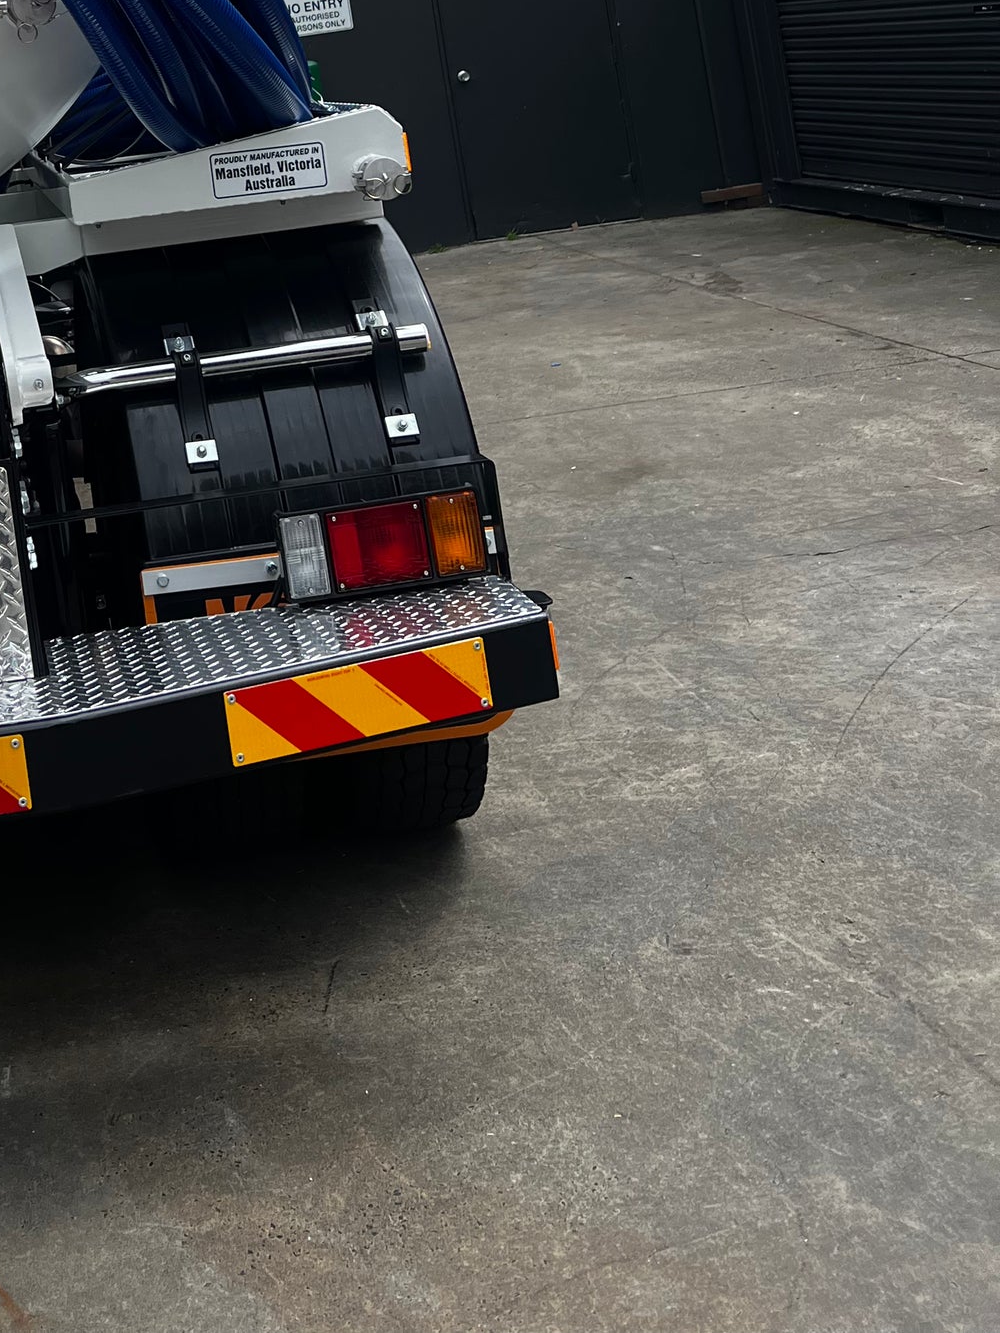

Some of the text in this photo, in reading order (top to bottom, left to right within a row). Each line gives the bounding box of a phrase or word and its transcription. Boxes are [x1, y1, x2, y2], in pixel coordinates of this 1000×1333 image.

[325, 19, 346, 29] ONLY
[214, 146, 319, 165] PROUDLY MANUFACTURED IN
[215, 157, 322, 180] Mansfield, Victoria
[245, 175, 296, 192] Australia
